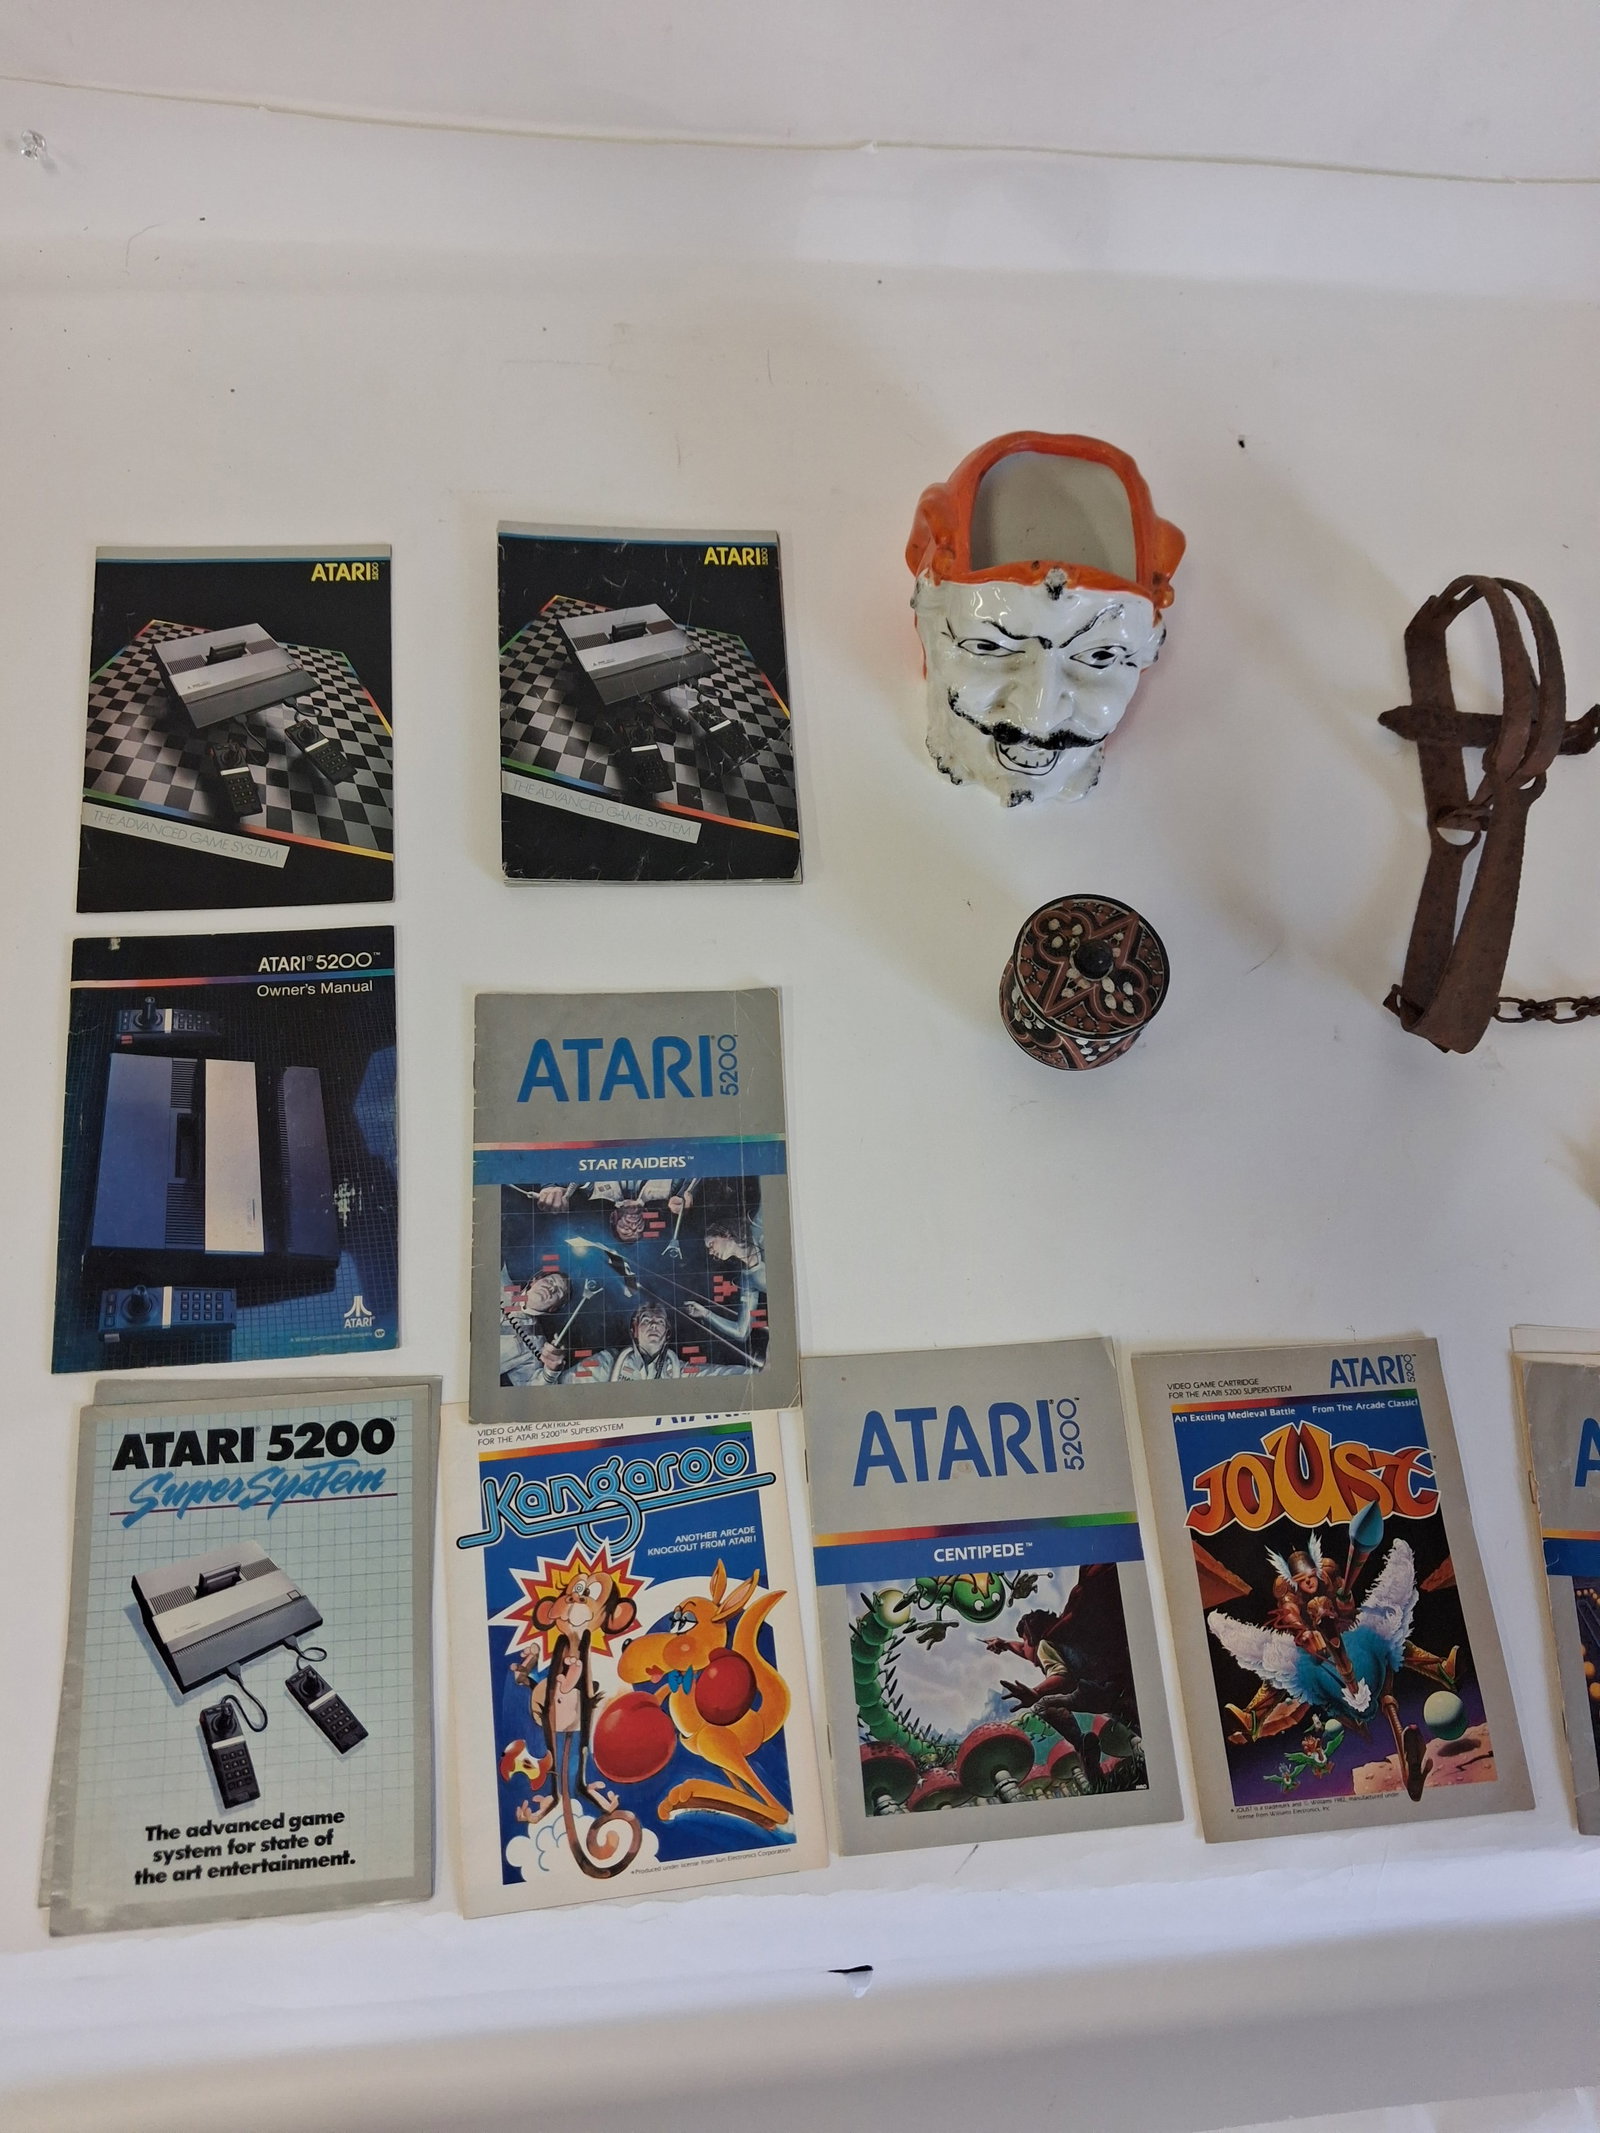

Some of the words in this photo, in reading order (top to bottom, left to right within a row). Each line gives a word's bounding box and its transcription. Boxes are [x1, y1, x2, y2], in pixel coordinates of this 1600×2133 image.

[704, 547, 761, 565] ATARI
[311, 563, 371, 581] ATARI
[513, 780, 534, 794] THE
[537, 786, 604, 813] ADVANCED
[606, 807, 643, 824] GAME
[646, 817, 691, 836] SYSTEM
[94, 810, 115, 825] THE
[117, 816, 188, 840] ADVANCED
[190, 832, 229, 850] GAME
[231, 842, 279, 860] SYSTEM
[257, 984, 316, 997] Owner's
[321, 980, 373, 994] Manual
[517, 1035, 713, 1102] ATARI
[717, 1034, 739, 1096] 5200
[579, 1159, 618, 1171] STAR
[1330, 1355, 1405, 1388] ATARI
[1403, 1354, 1416, 1383] 5200
[1167, 1382, 1191, 1390] VIDEO
[1193, 1380, 1215, 1389] GAME
[1218, 1378, 1259, 1387] CARTRIDGE
[1168, 1391, 1184, 1399] FOR
[1186, 1390, 1199, 1398] THE
[1202, 1389, 1222, 1397] ATARI
[1224, 1388, 1242, 1396] 5200
[1243, 1385, 1293, 1395] SUPERSYSTEM
[1174, 1415, 1188, 1423] An
[1190, 1412, 1225, 1422] Exciting
[1228, 1409, 1267, 1420] Medieval
[1269, 1407, 1296, 1417] Battle
[1312, 1405, 1335, 1414] From
[1337, 1403, 1353, 1411] The
[1355, 1400, 1385, 1410] Arcade
[1387, 1398, 1418, 1408] Classic!
[477, 1427, 505, 1437] VIDEO
[507, 1424, 533, 1434] GAME
[477, 1437, 495, 1446] FOR
[497, 1436, 513, 1444] THE
[515, 1433, 539, 1442] ATARI
[570, 1423, 624, 1436] SUPERSYSTEM
[853, 1399, 1058, 1487] ATARI
[1057, 1397, 1085, 1471] 5200
[1183, 1420, 1441, 1537] JOUST
[457, 1440, 774, 1557] Kangaroo
[648, 1543, 697, 1556] KNOCKOUT
[700, 1539, 726, 1550] FROM
[675, 1530, 717, 1543] ANOTHER
[720, 1526, 756, 1537] ARCADE
[146, 1824, 180, 1842] The
[186, 1812, 285, 1838] advanced
[289, 1811, 345, 1832] game
[153, 1844, 222, 1866] system
[228, 1838, 256, 1856] for
[261, 1835, 309, 1852] state
[314, 1828, 335, 1845] of
[727, 1853, 757, 1862] Electronics
[757, 1847, 792, 1858] Corporation
[134, 1868, 168, 1886] the
[172, 1865, 202, 1881] art
[207, 1850, 356, 1878] entertainment.
